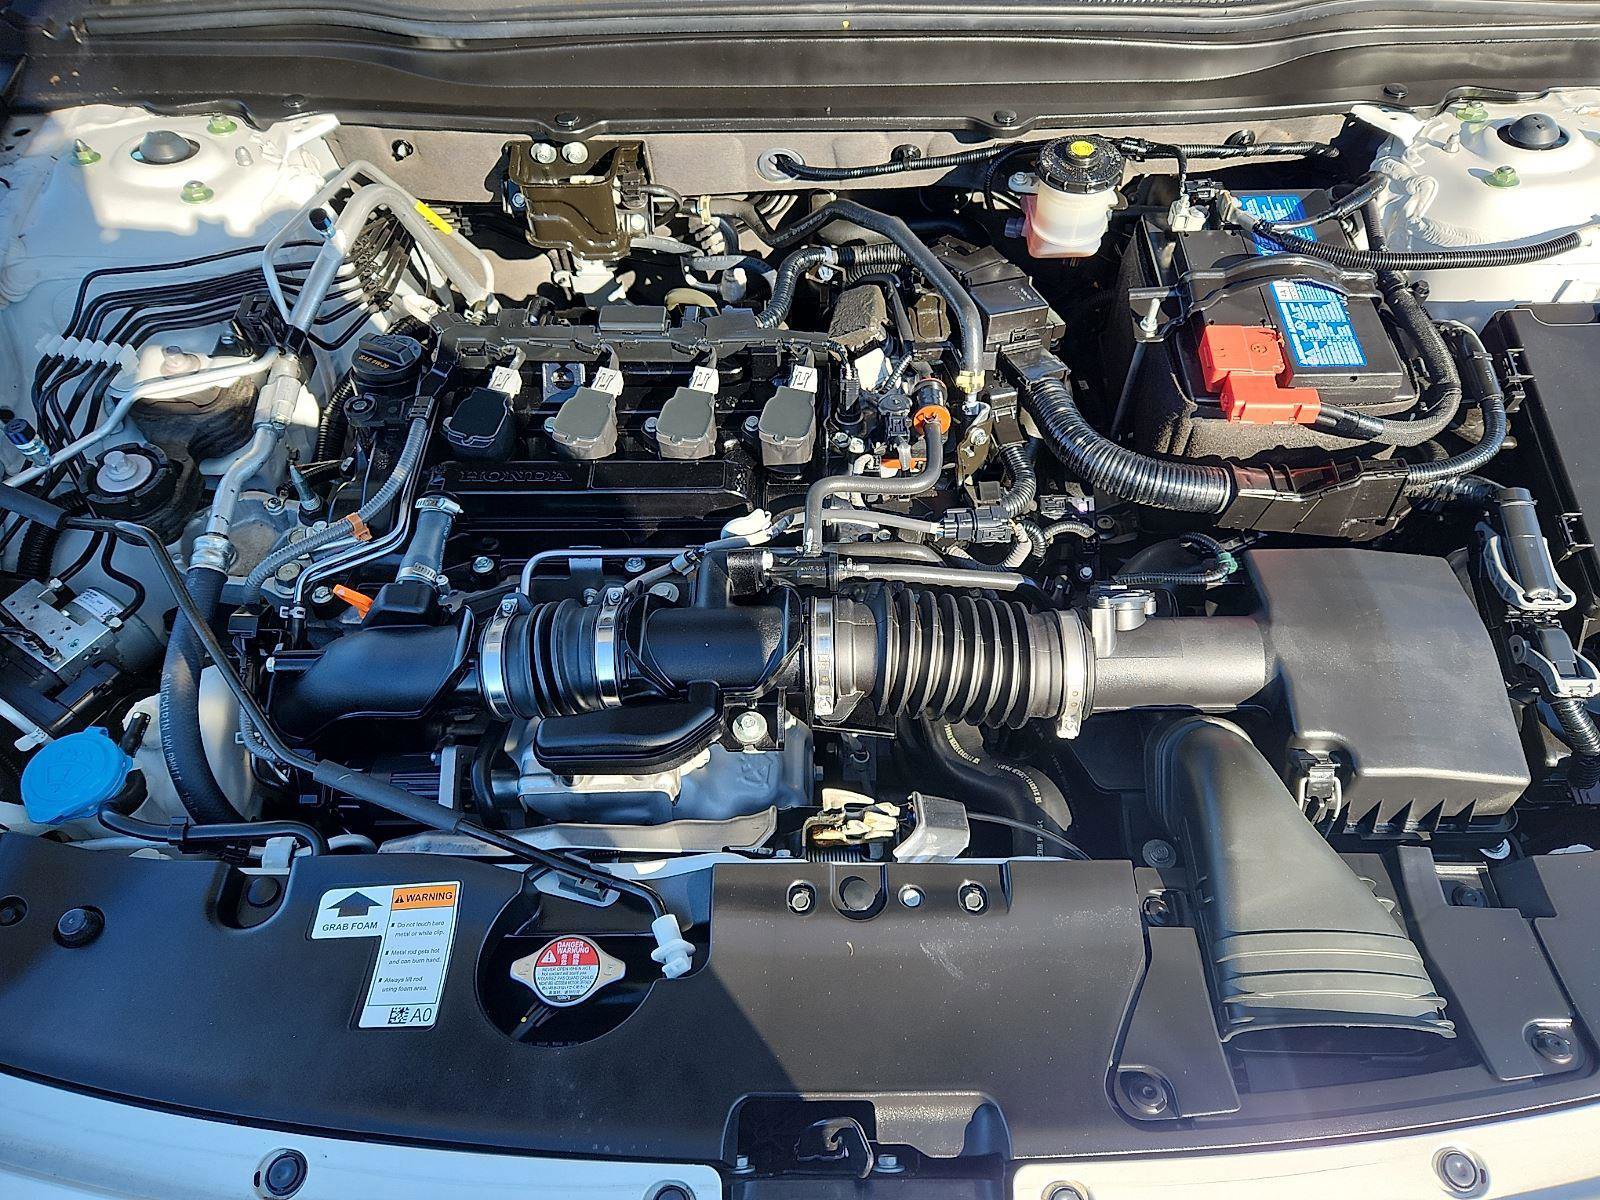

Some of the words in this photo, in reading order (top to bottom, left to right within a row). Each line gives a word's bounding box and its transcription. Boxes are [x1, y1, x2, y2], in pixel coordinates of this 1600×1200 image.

[459, 470, 572, 482] HONDA
[406, 892, 452, 903] WARNING
[322, 923, 348, 932] GRAB
[350, 921, 378, 930] FOAM
